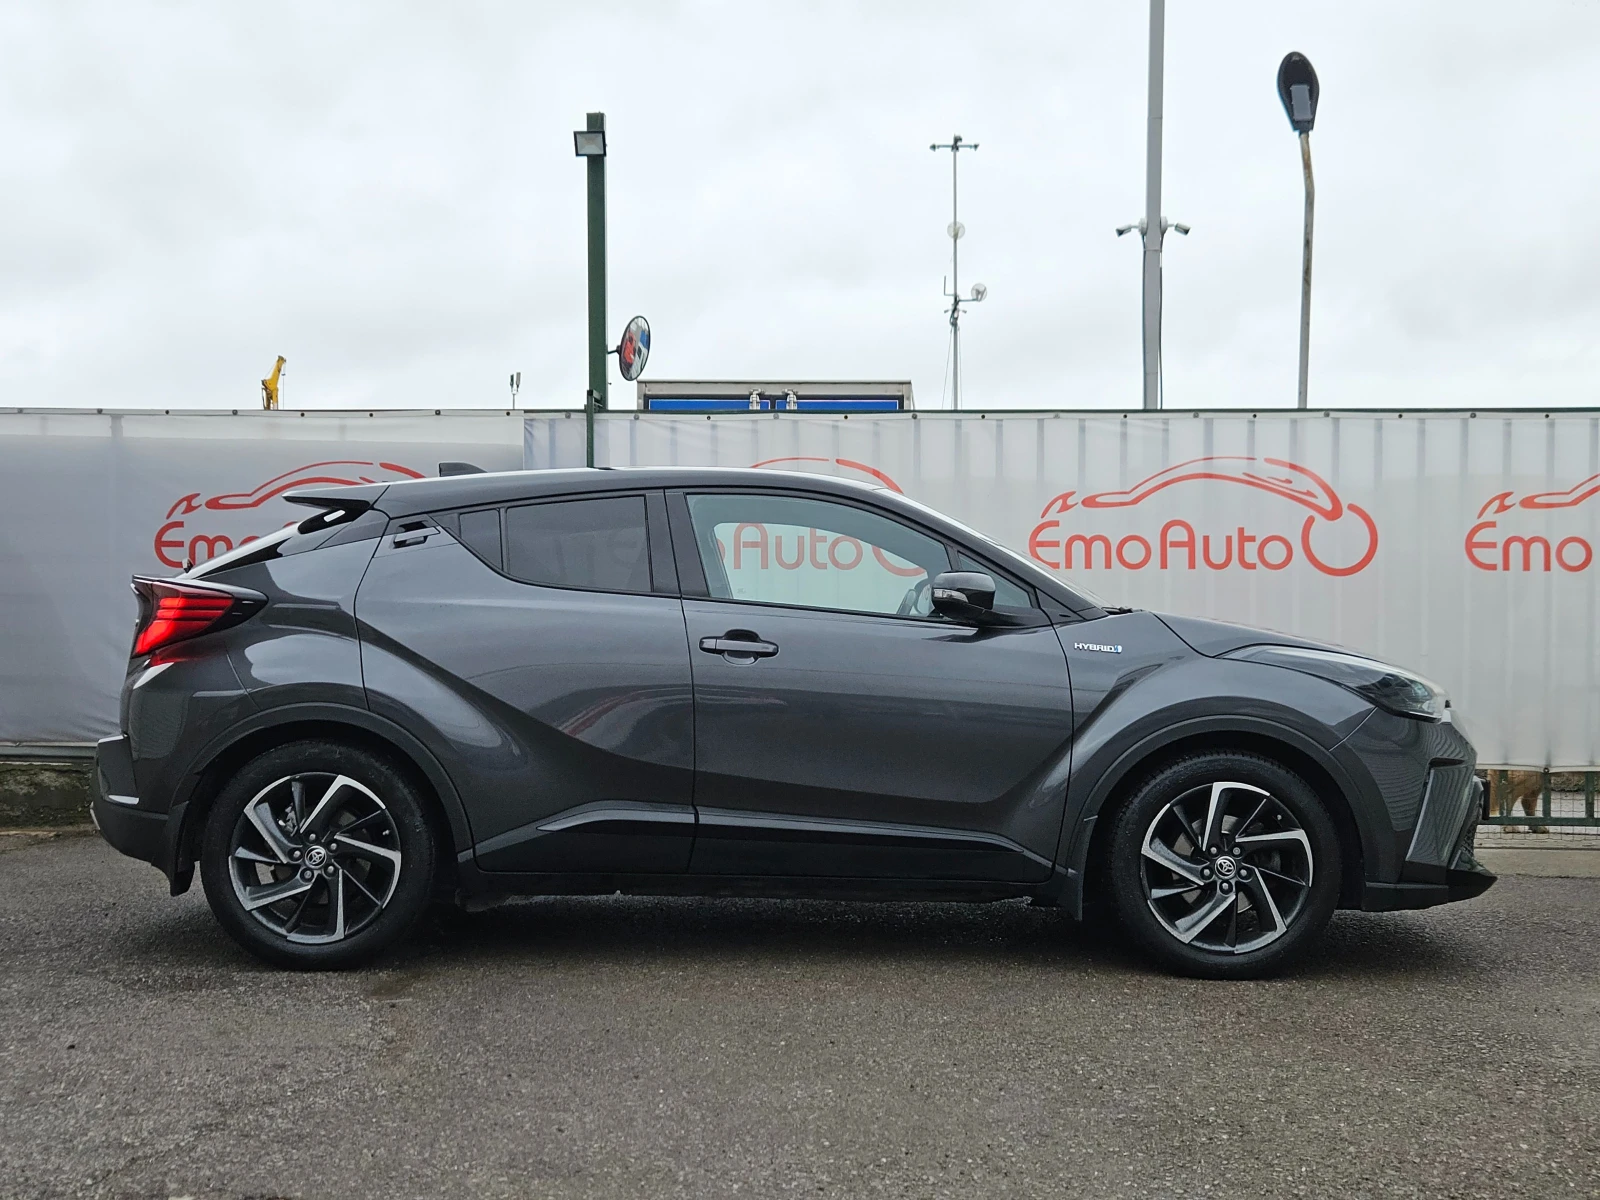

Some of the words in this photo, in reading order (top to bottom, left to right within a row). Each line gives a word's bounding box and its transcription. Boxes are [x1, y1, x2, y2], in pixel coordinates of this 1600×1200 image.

[155, 521, 261, 568] Em
[716, 522, 863, 570] Auto
[1029, 519, 1293, 570] EmoAuto
[1465, 521, 1593, 572] Emo
[1074, 642, 1115, 653] HYBRID
